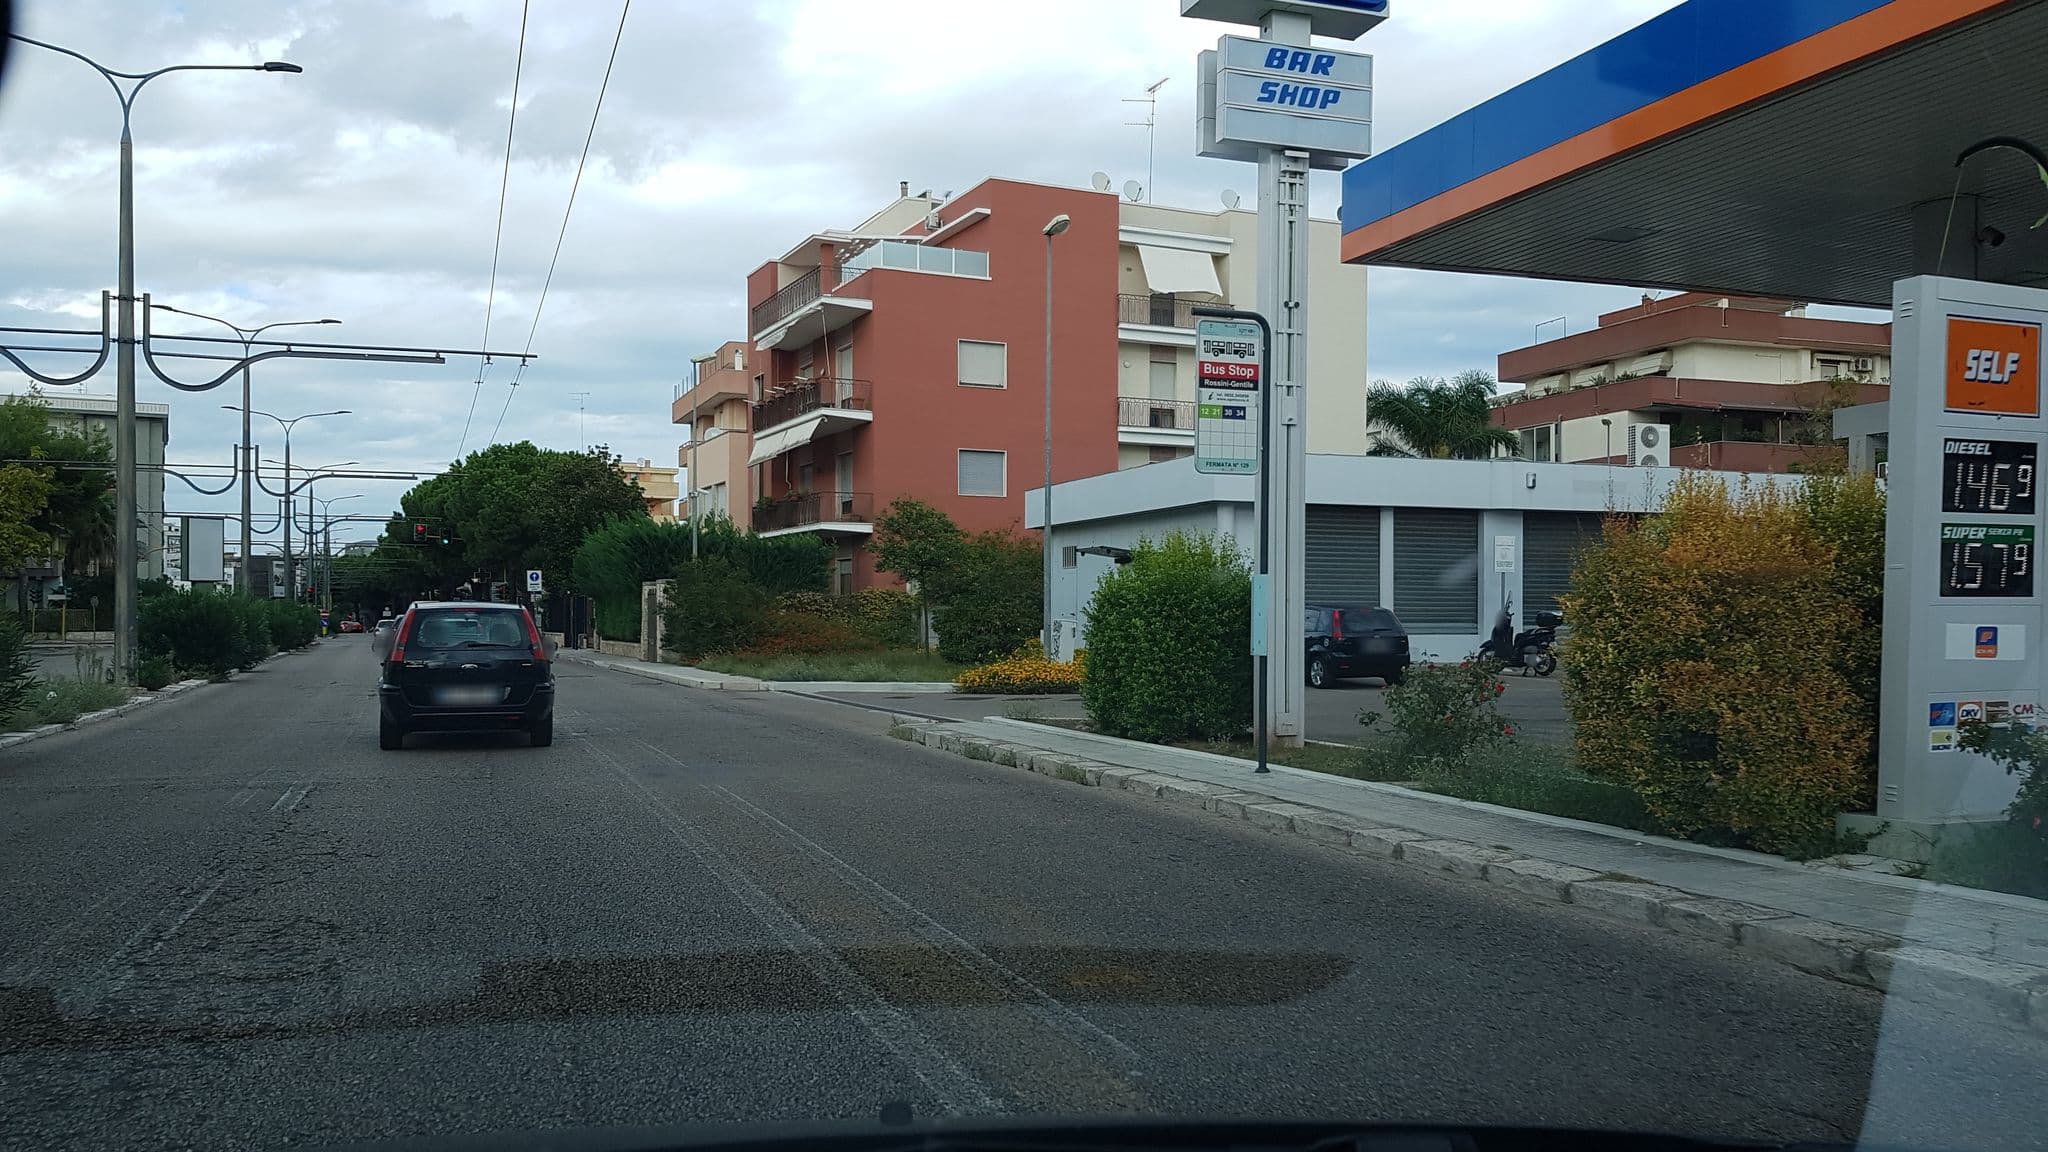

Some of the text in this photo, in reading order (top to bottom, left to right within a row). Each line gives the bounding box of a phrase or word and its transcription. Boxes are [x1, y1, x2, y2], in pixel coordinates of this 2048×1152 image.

[1264, 47, 1336, 76] BAR
[1256, 81, 1341, 110] SHOP
[1204, 363, 1254, 379] Bus Stop
[1964, 348, 2020, 384] SELF
[1204, 379, 1254, 388] Rossini-Gentile
[1945, 441, 1992, 455] DIESEL
[1942, 527, 1987, 540] SUPER
[1960, 708, 1980, 718] DKV
